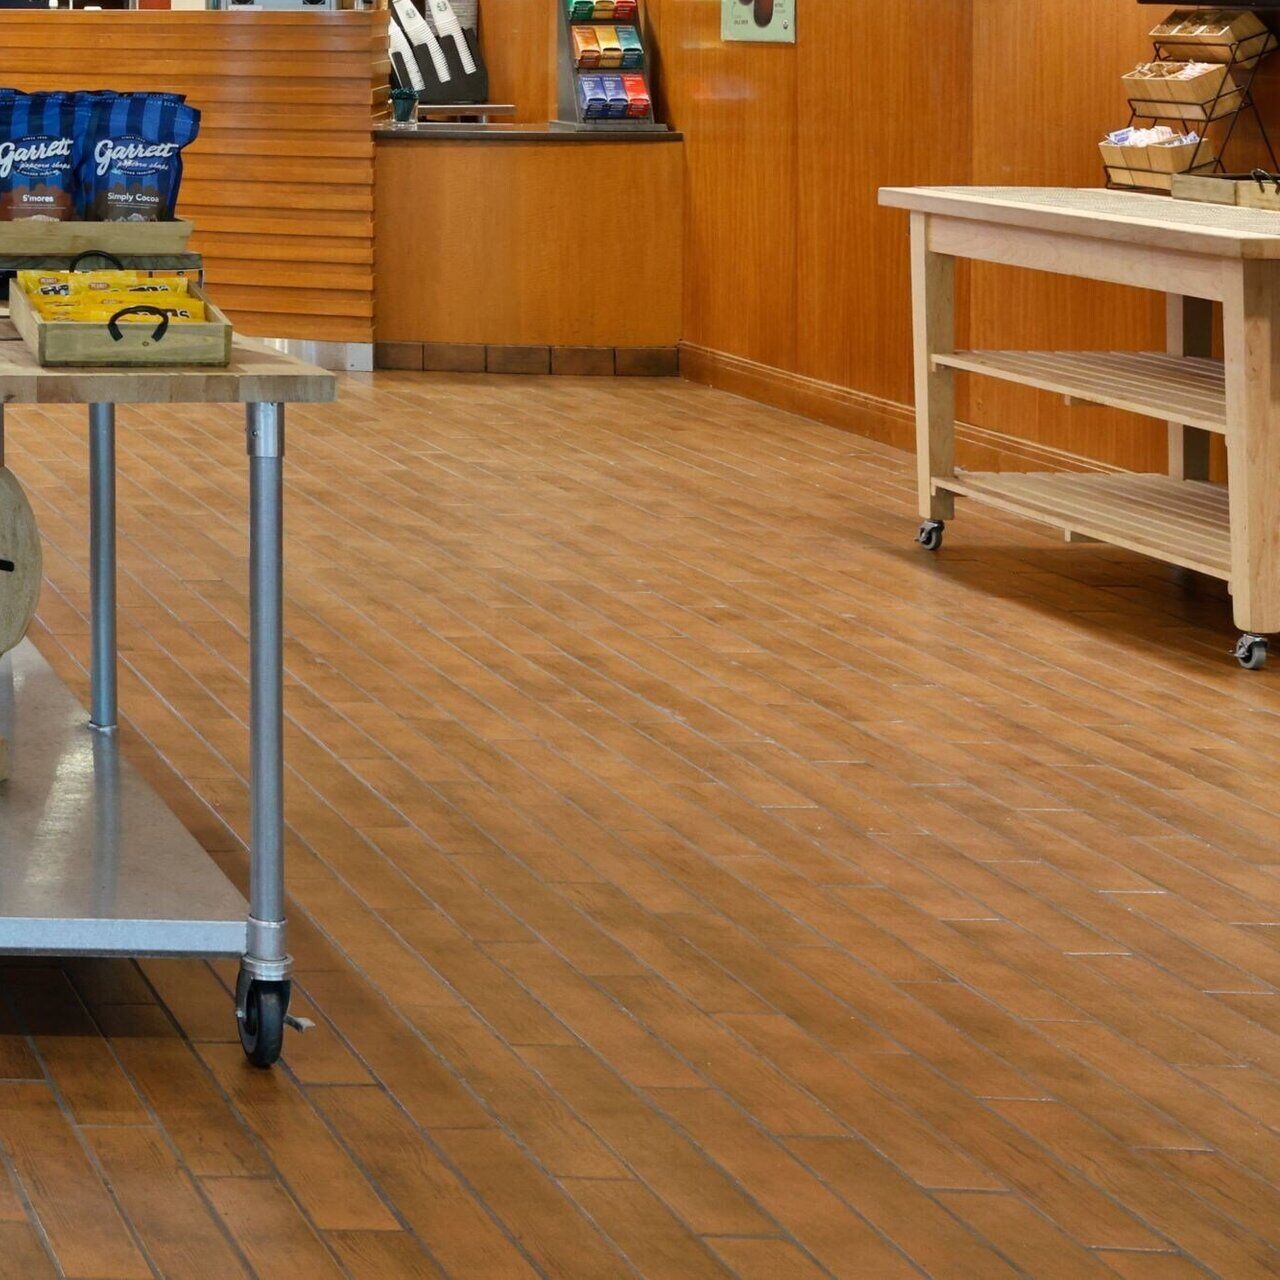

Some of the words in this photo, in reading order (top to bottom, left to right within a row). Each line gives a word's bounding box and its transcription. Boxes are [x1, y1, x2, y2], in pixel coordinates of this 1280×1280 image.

[94, 140, 179, 176] Garrett
[22, 194, 54, 202] S'mores
[107, 192, 134, 202] Simply
[135, 194, 160, 203] Cocoa
